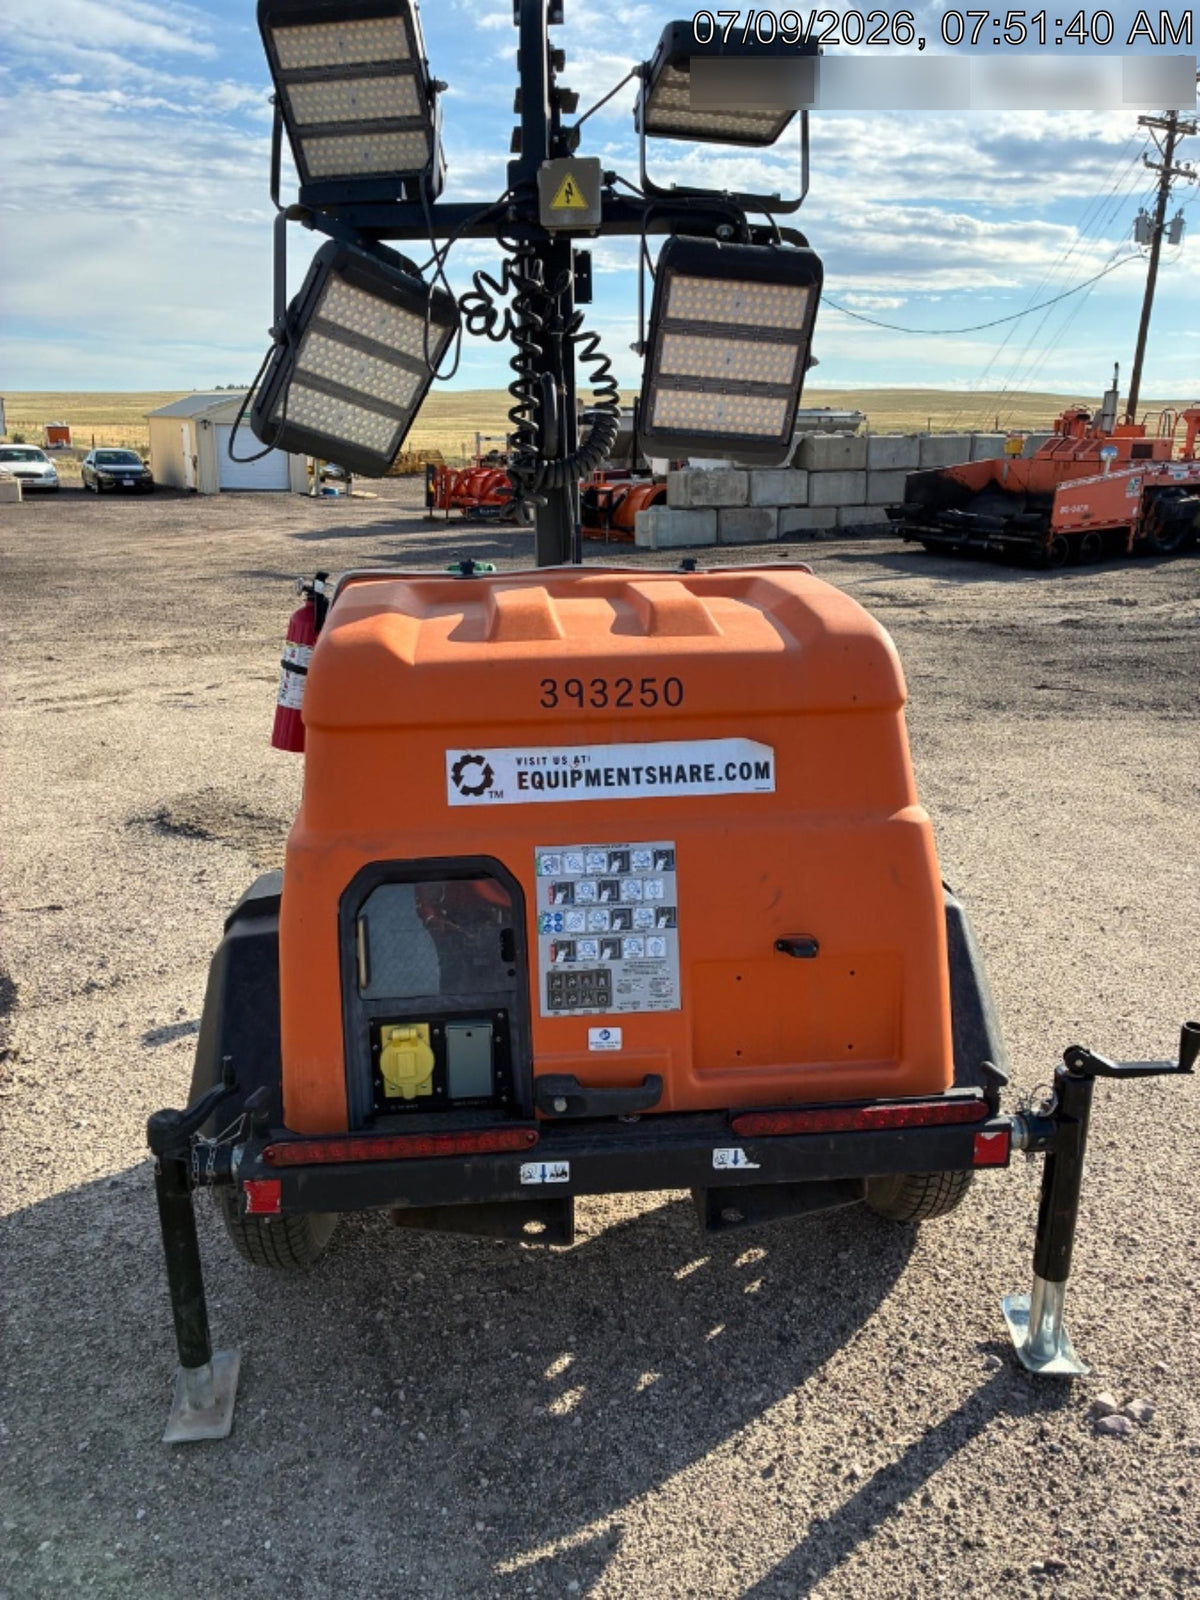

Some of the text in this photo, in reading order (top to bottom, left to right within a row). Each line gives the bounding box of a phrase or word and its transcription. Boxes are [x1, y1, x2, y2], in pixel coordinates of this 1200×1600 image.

[539, 677, 684, 708] 393250
[515, 756, 548, 766] VISIT
[552, 755, 568, 765] US
[517, 761, 771, 791] EQUIPMENTSHARE.COM
[488, 790, 504, 798] TM
